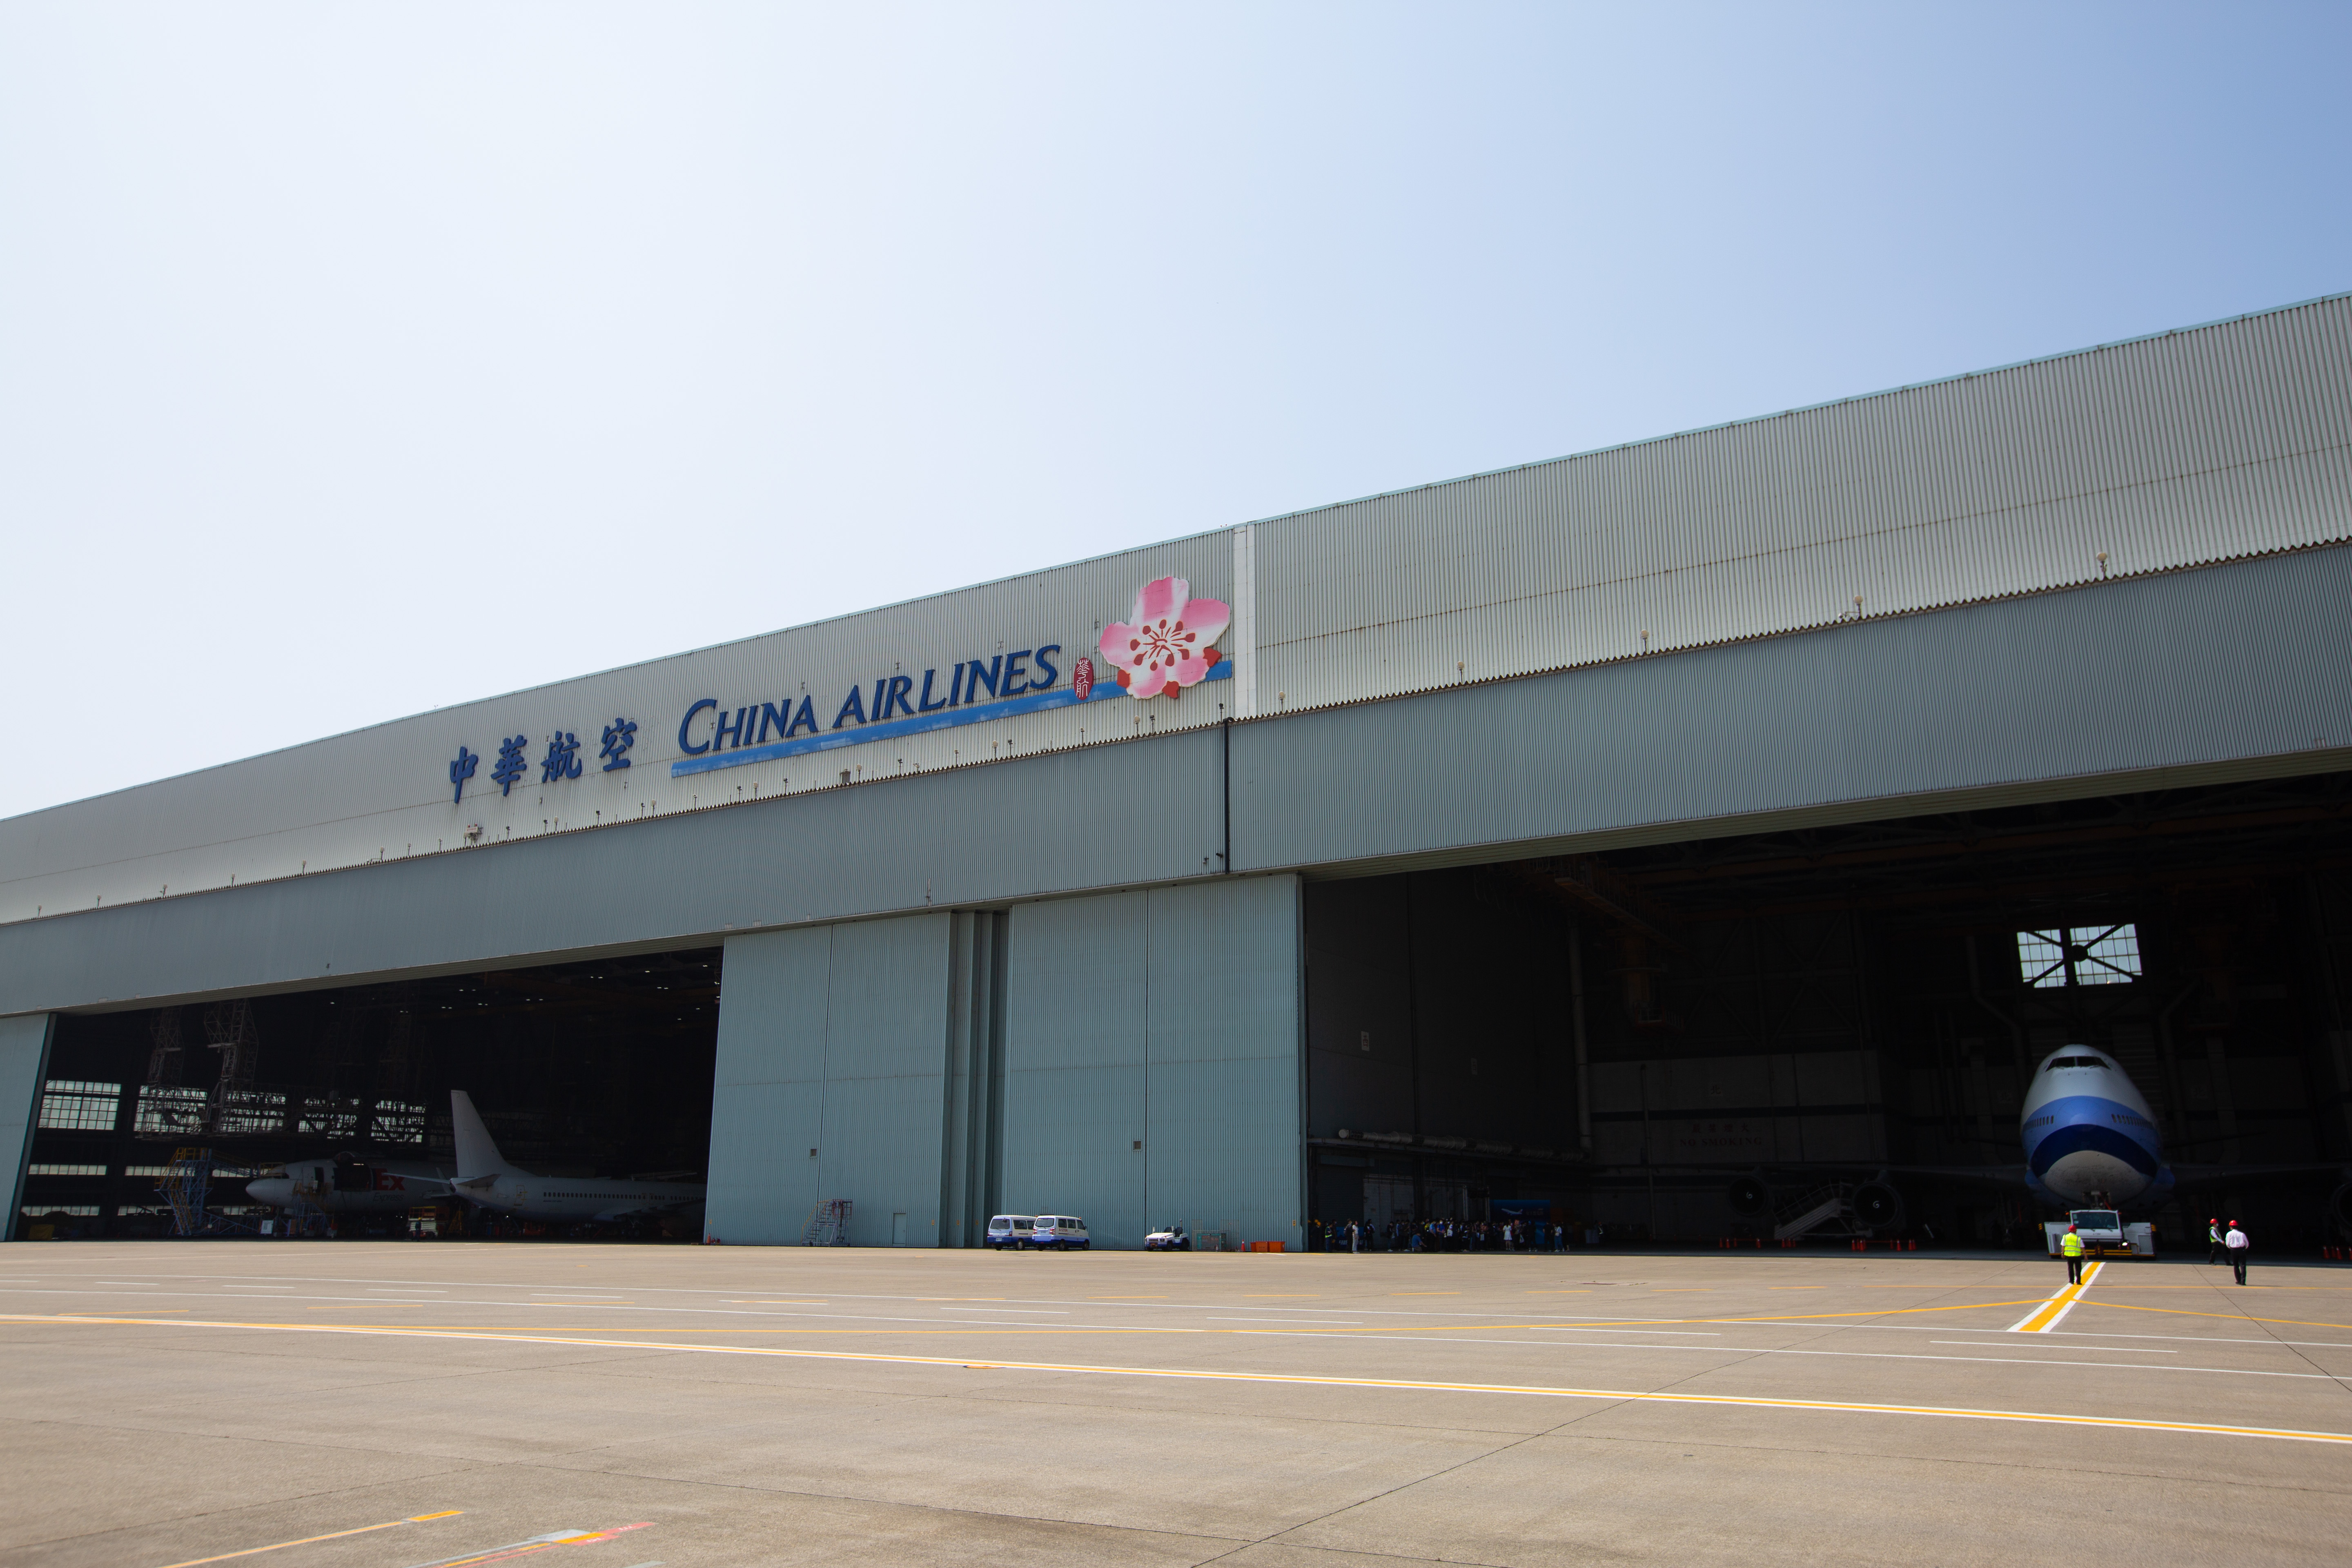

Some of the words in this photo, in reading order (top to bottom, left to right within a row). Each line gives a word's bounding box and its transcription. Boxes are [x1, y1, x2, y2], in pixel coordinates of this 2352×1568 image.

[678, 695, 818, 754] CHINA
[832, 644, 1060, 728] AIRLINES
[450, 717, 637, 804] 中華航空
[1702, 1137, 1762, 1146] SMOKING
[372, 1168, 405, 1191] Ex
[373, 1192, 404, 1203] Express
